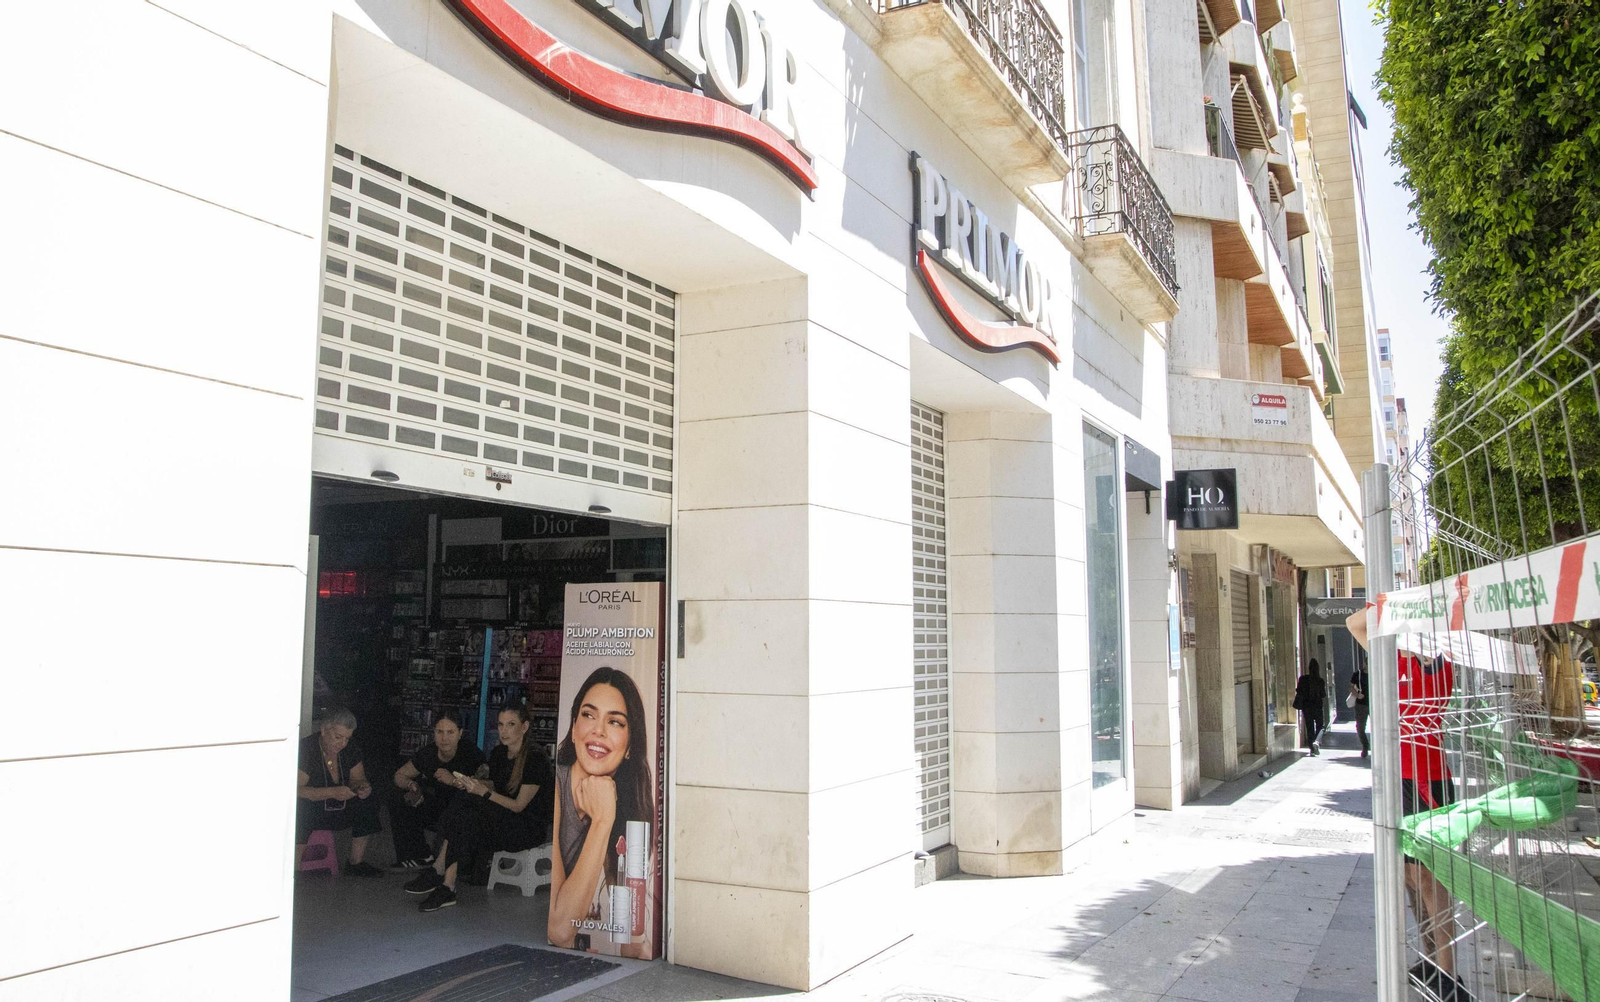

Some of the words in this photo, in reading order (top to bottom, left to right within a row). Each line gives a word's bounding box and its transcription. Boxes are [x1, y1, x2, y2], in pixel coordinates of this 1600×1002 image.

[913, 152, 1058, 345] PRIMOR
[533, 515, 578, 535] Dior
[441, 566, 469, 576] NYX
[579, 589, 642, 604] L'ORÉAL
[1315, 606, 1353, 615] JOYERÍA
[566, 627, 599, 638] PLUMP
[600, 627, 654, 638] AMBITION
[565, 648, 586, 656] ÁCIDO
[588, 648, 635, 656] HIALURÓNICO
[659, 729, 665, 747] DE
[571, 919, 582, 928] TÚ
[584, 920, 595, 929] LO
[597, 922, 627, 933] VALES.
